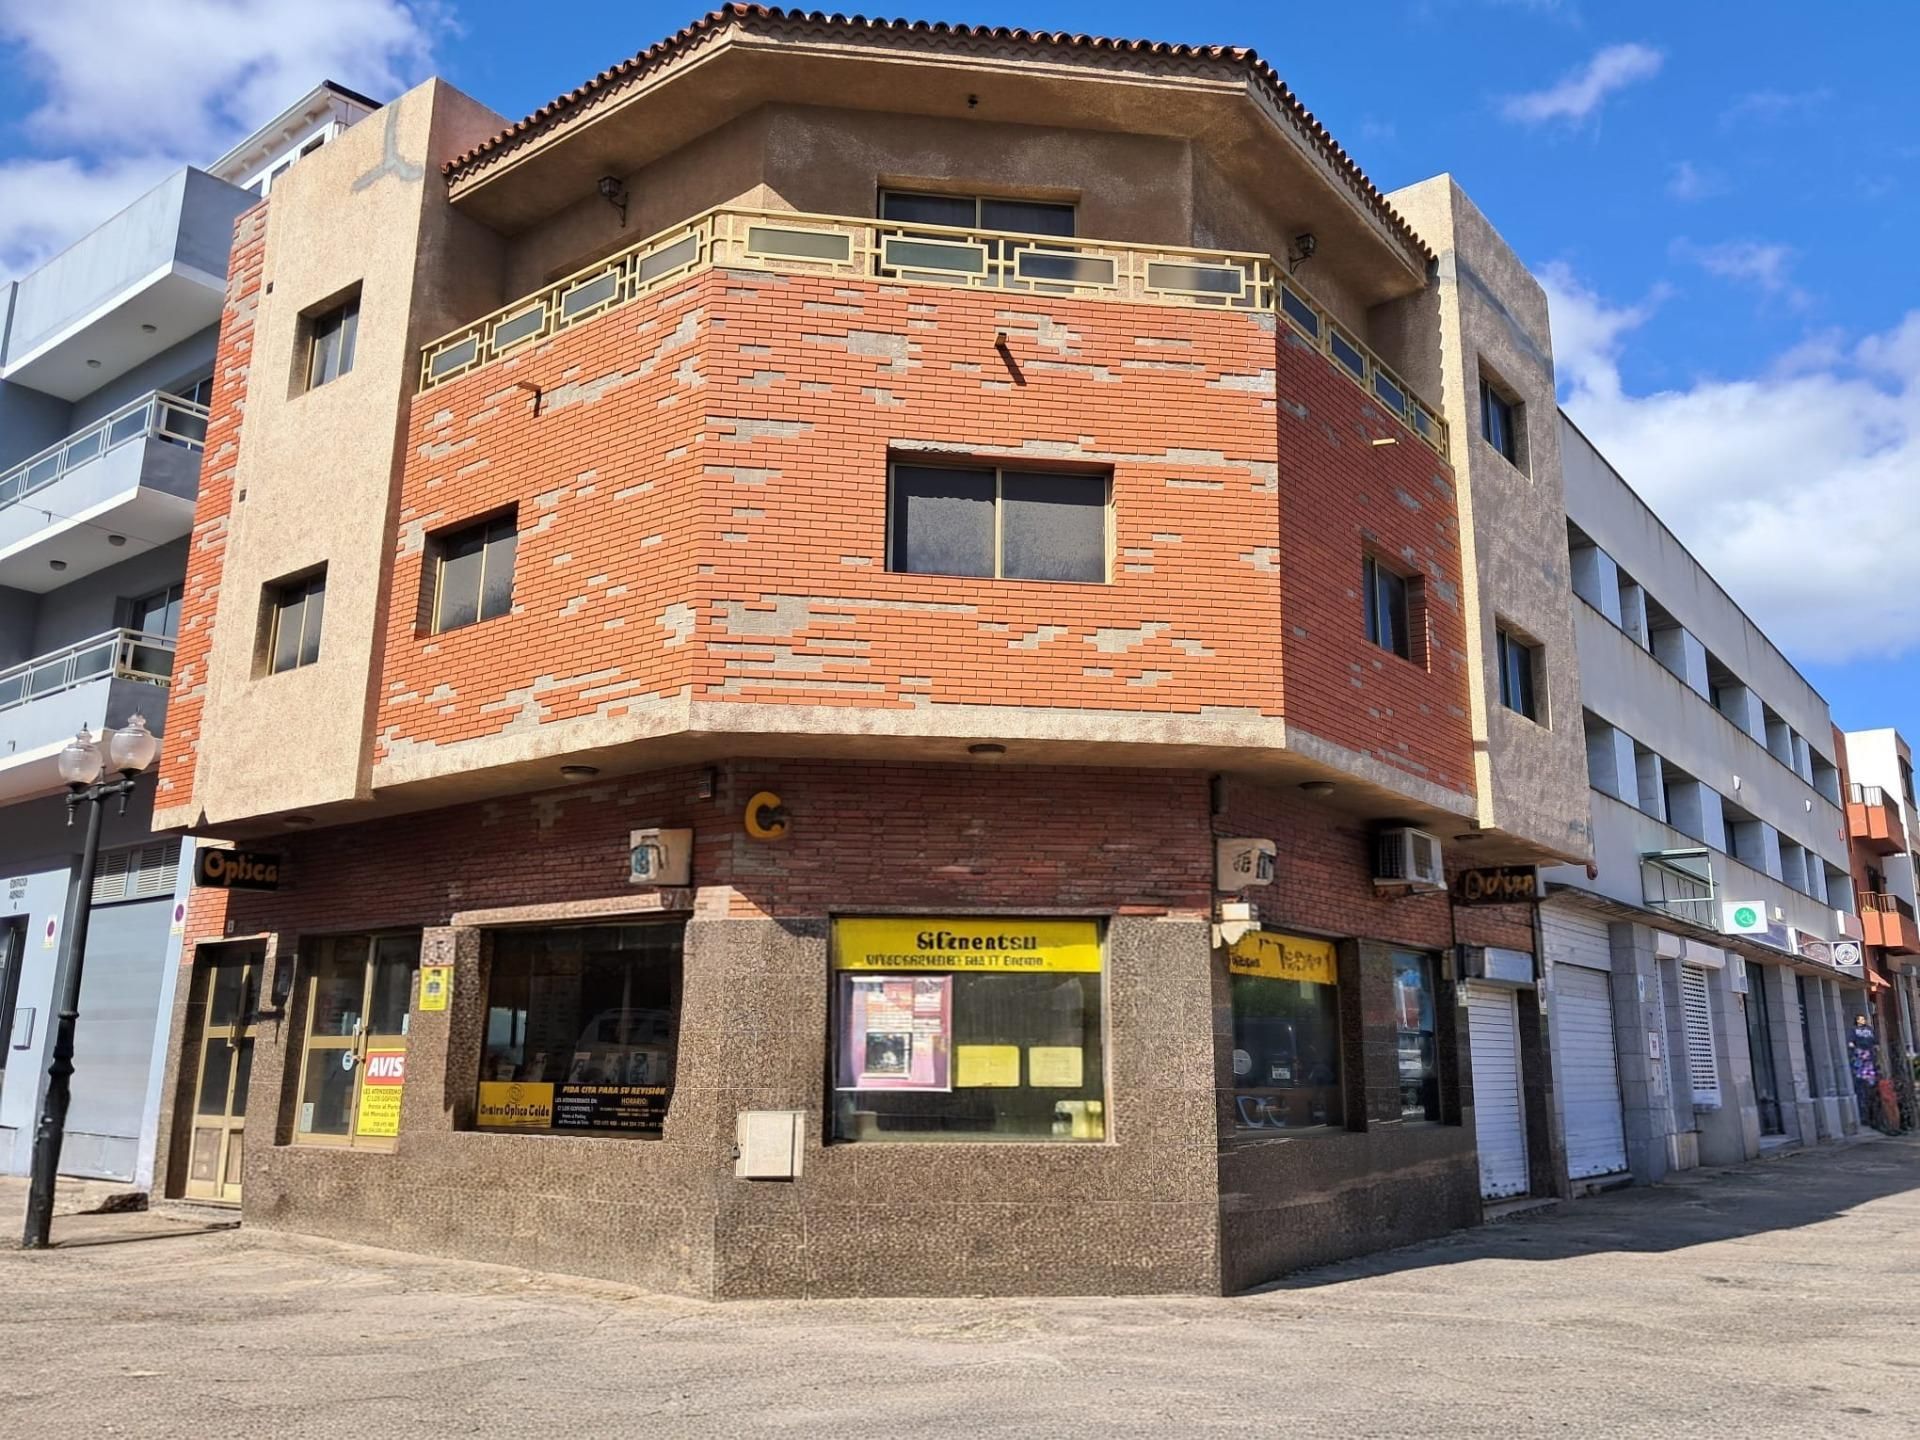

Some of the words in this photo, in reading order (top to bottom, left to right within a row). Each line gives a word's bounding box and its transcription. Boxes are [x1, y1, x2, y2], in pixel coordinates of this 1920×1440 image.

[562, 1086, 580, 1094] PIDA
[581, 1086, 597, 1094] CITA
[598, 1086, 618, 1094] PARA
[620, 1087, 630, 1095] SU
